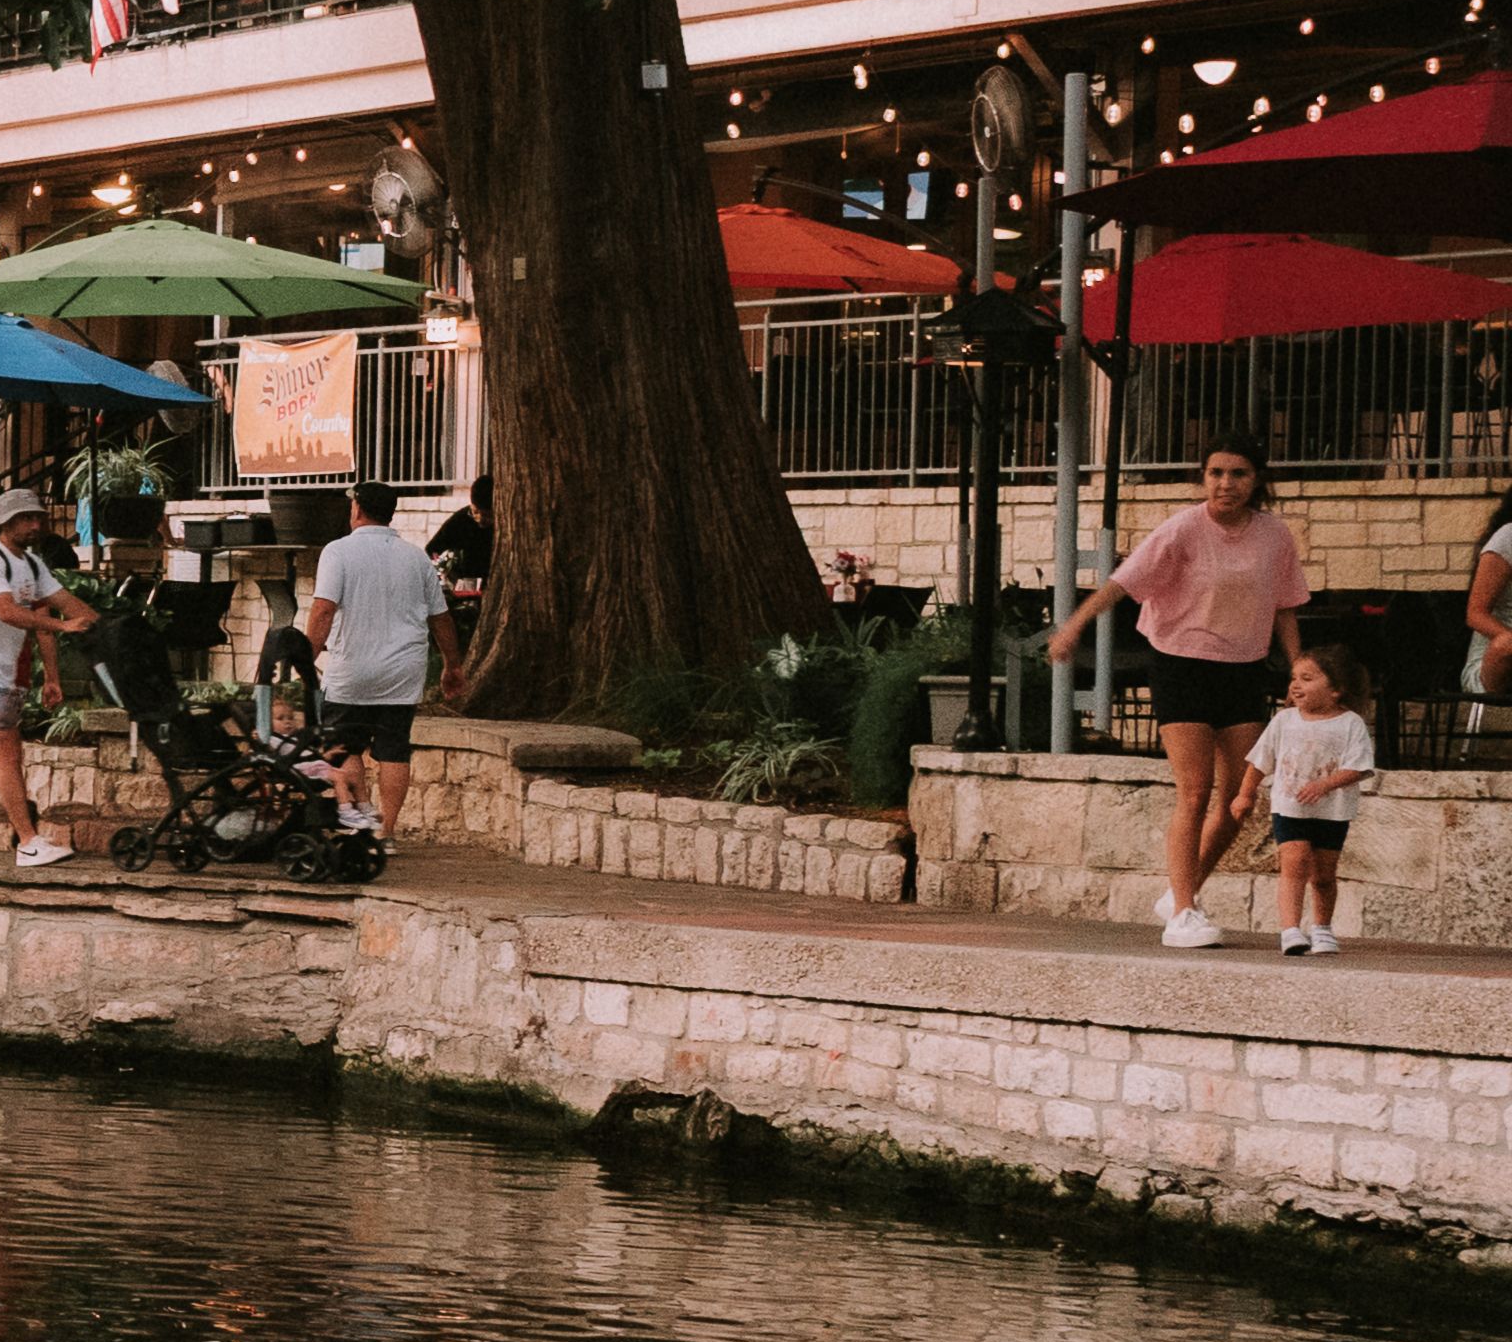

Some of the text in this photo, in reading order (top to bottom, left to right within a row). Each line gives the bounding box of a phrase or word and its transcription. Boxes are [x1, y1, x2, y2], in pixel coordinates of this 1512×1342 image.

[260, 355, 331, 407] Shiner
[276, 391, 317, 421] BOCK
[301, 411, 351, 437] Country
